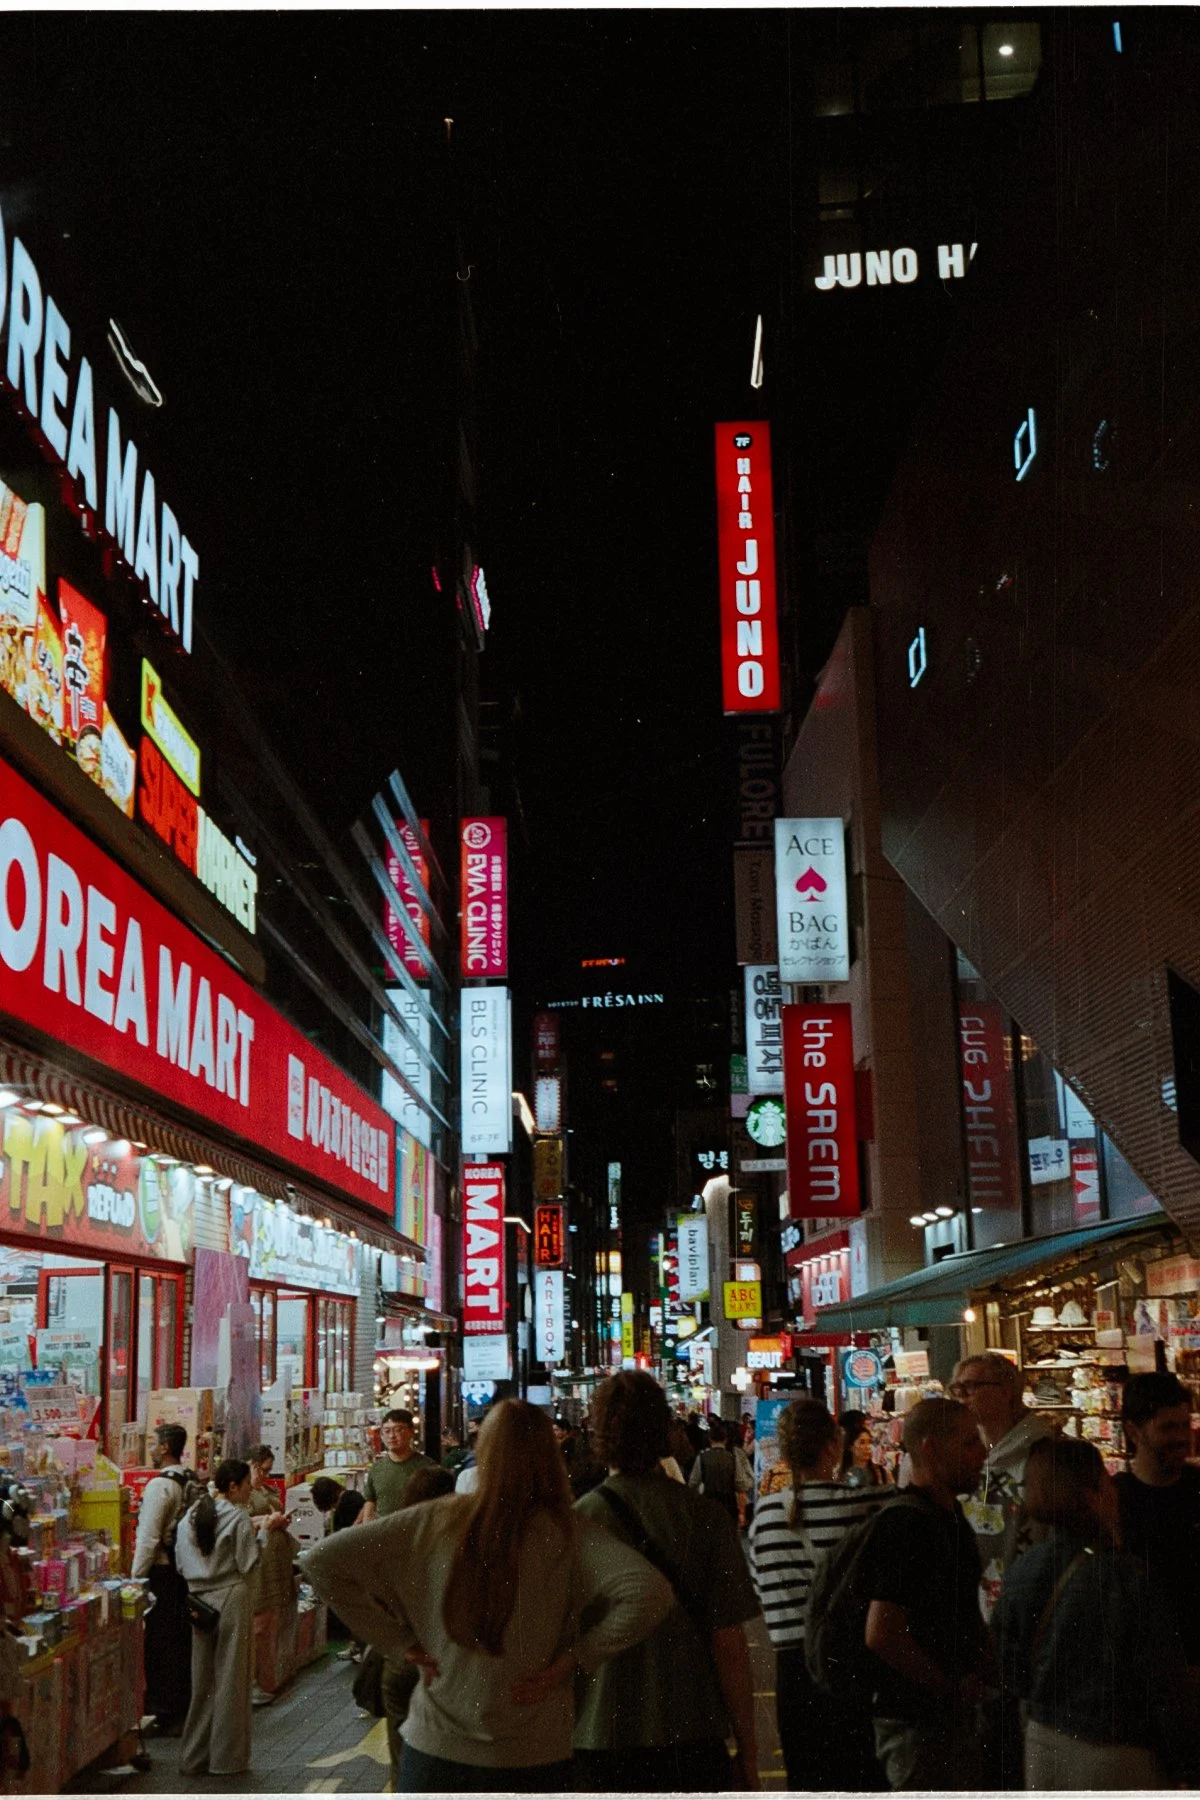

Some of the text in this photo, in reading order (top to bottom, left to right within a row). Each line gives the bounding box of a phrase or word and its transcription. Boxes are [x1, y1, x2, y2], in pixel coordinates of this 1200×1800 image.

[814, 243, 978, 290] JUNO H
[734, 436, 751, 448] 7F
[105, 406, 199, 655] MART
[736, 458, 765, 698] HAIR JUNO
[139, 735, 199, 878] SUPER
[785, 835, 835, 856] ACE
[467, 854, 487, 898] EVIA
[467, 901, 488, 970] CLINIC
[788, 912, 838, 934] BAG
[789, 936, 838, 951] かばん
[582, 991, 635, 1008] FRÉSA
[638, 994, 664, 1004] INN
[157, 943, 255, 1107] MART
[802, 1018, 834, 1069] the
[470, 1000, 488, 1115] BLS CLINIC
[3, 1113, 88, 1227] TAX
[464, 1168, 502, 1179] KOREA
[87, 1183, 136, 1228] REFUND
[466, 1184, 499, 1314] MART
[540, 1211, 551, 1261] HAIR
[729, 1288, 757, 1301] ABC
[729, 1302, 757, 1312] MART
